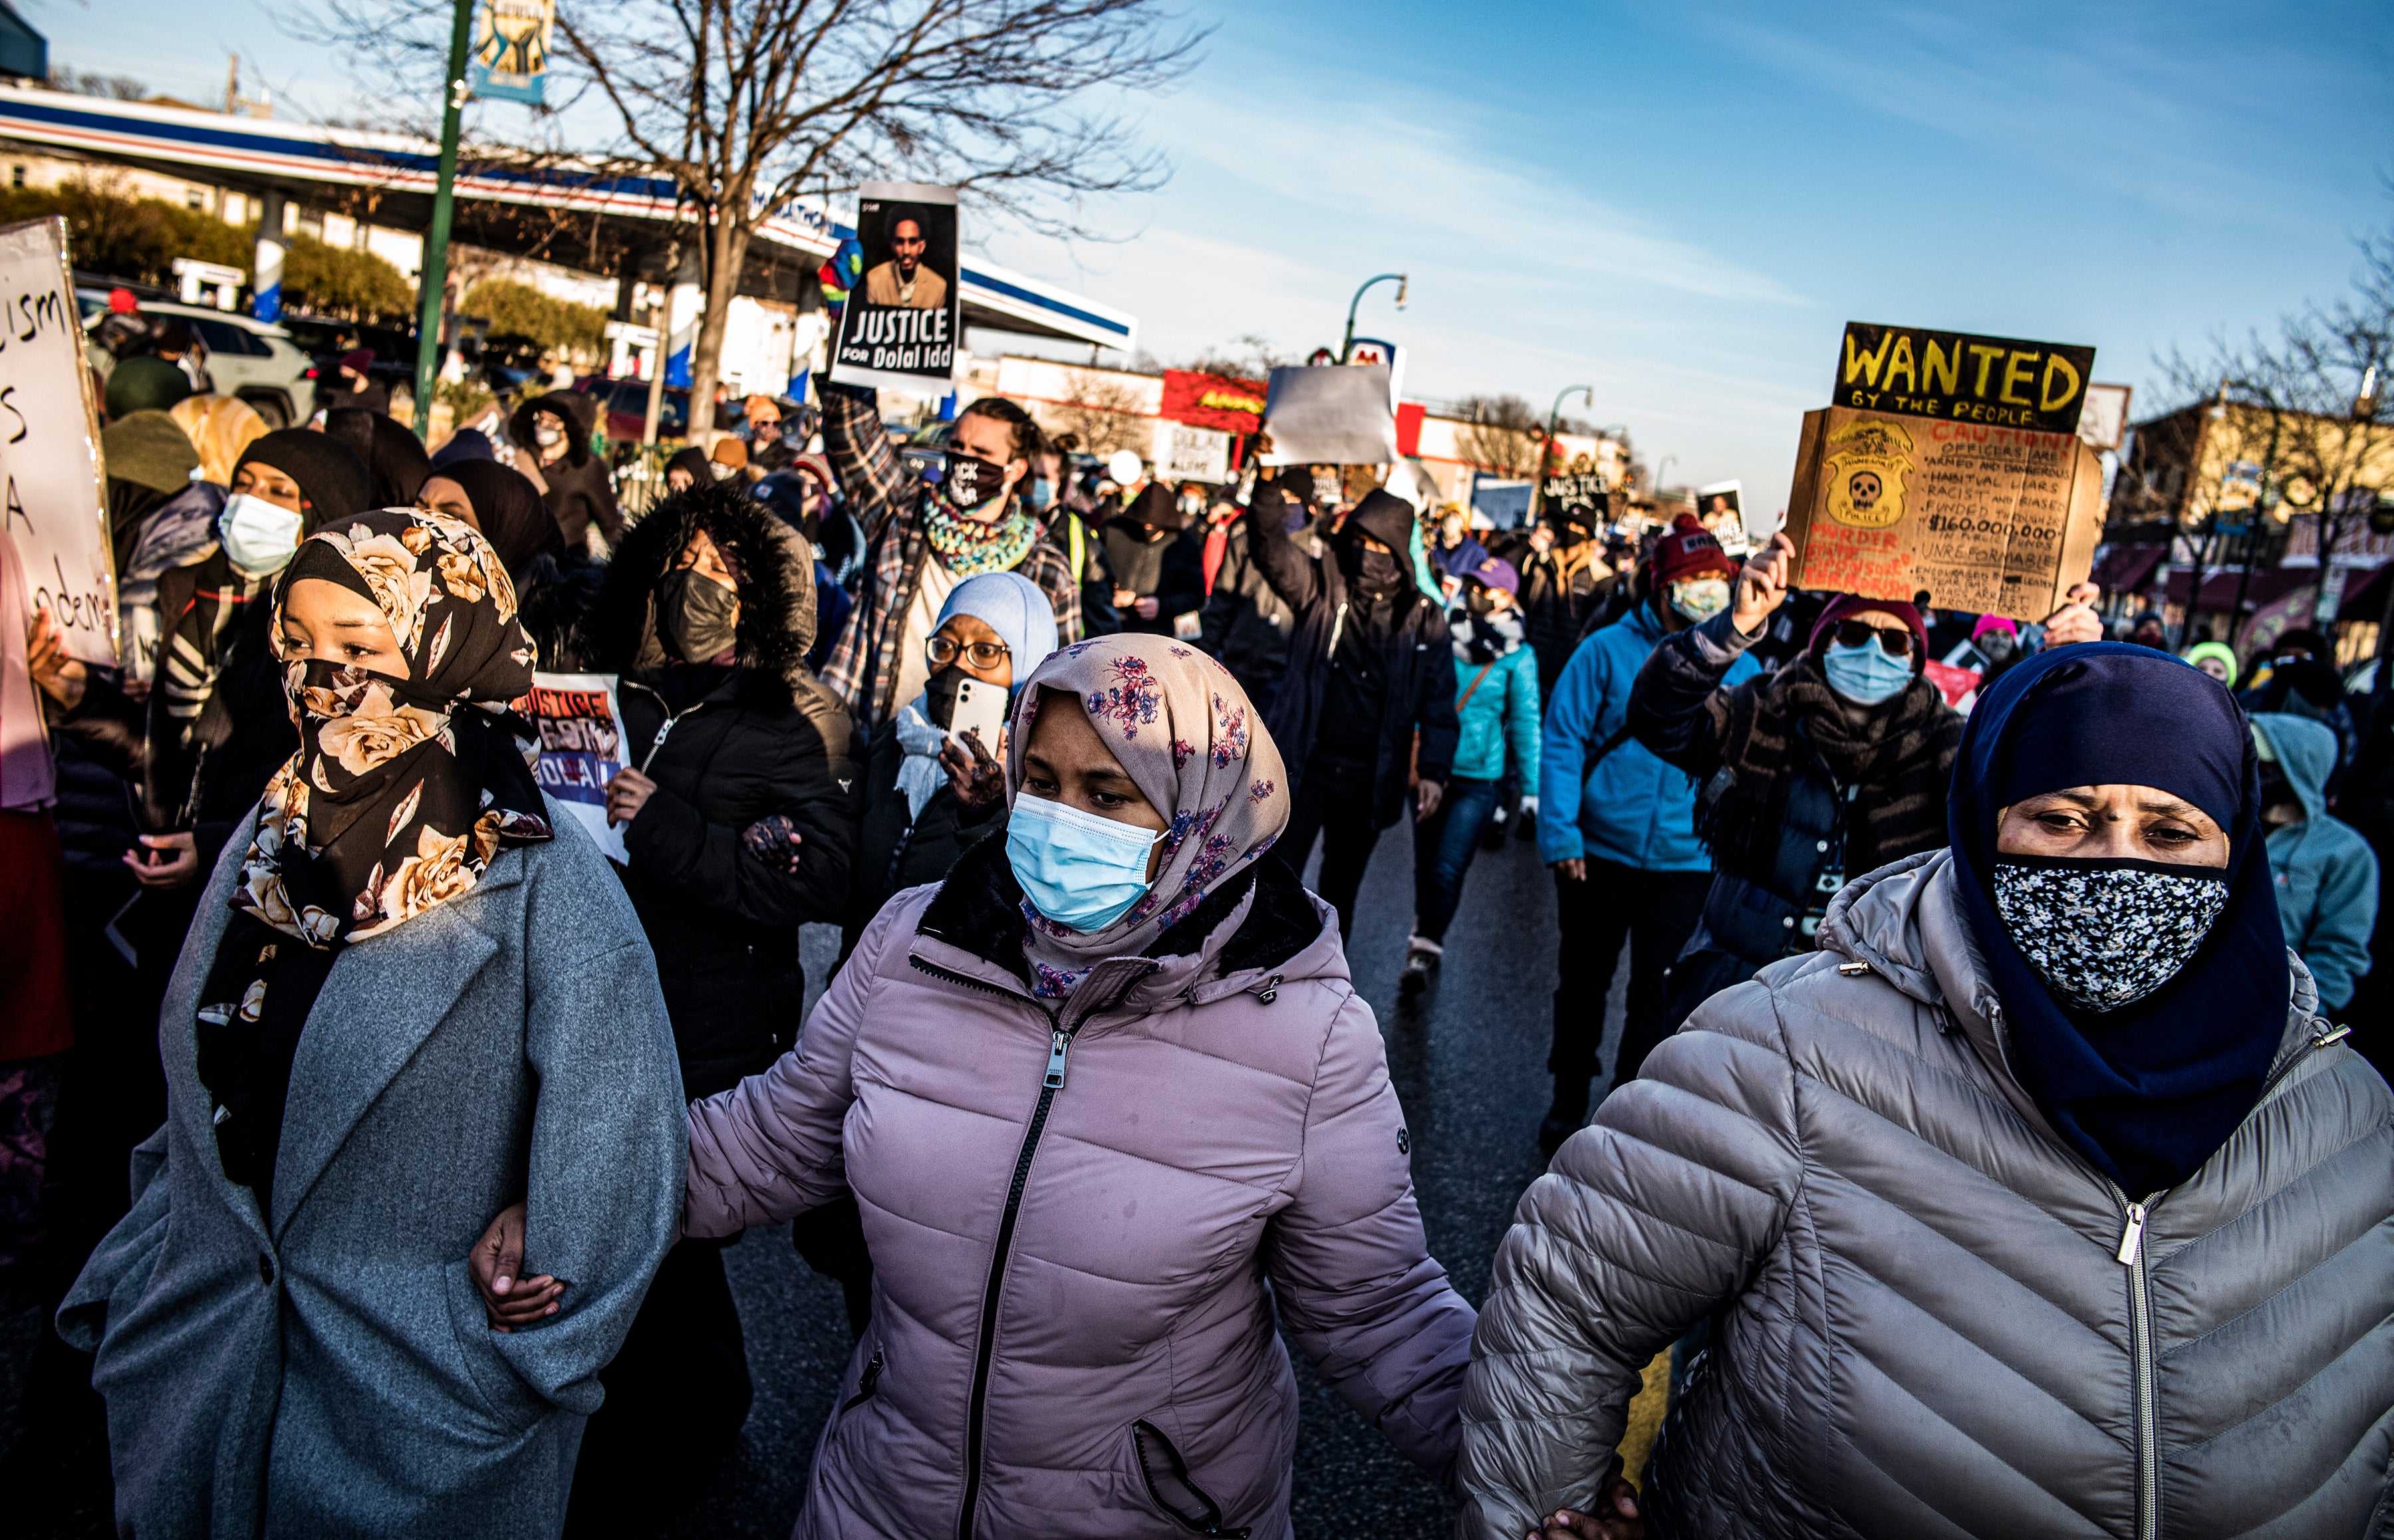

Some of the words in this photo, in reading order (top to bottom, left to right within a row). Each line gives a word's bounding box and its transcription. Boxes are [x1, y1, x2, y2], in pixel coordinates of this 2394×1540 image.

[0, 290, 66, 352] ism
[851, 308, 948, 344] JUSTICE
[841, 346, 869, 362] FOR
[872, 344, 920, 368] Dolal
[924, 343, 952, 368] Idd
[1845, 331, 2079, 412] WANTED
[1896, 396, 1938, 415] THE
[1953, 402, 2033, 425] PEOPLE
[1931, 421, 2074, 457] CAUTION!
[1942, 443, 2022, 457] OFFICERS
[1928, 457, 1973, 468] ARMED
[1979, 461, 2000, 471] AND
[2004, 462, 2070, 479] DANGEROUS
[1543, 474, 1607, 497] JUSTICE
[1931, 472, 2002, 488] HABITUAL
[2011, 479, 2058, 494] LIARS
[6, 474, 35, 535] A
[1926, 501, 1988, 517] FUNDED
[1928, 485, 1990, 502] RACIST
[1992, 496, 2012, 505] AND
[2020, 497, 2064, 512] BIASED
[1845, 509, 1881, 521] POLICE
[1811, 521, 1898, 549] MURDER
[2010, 535, 2052, 551] FUNDS
[1922, 543, 2056, 569] UNREFORMABLE
[1804, 567, 1911, 601] TERRORISM
[518, 688, 600, 718] USTICE
